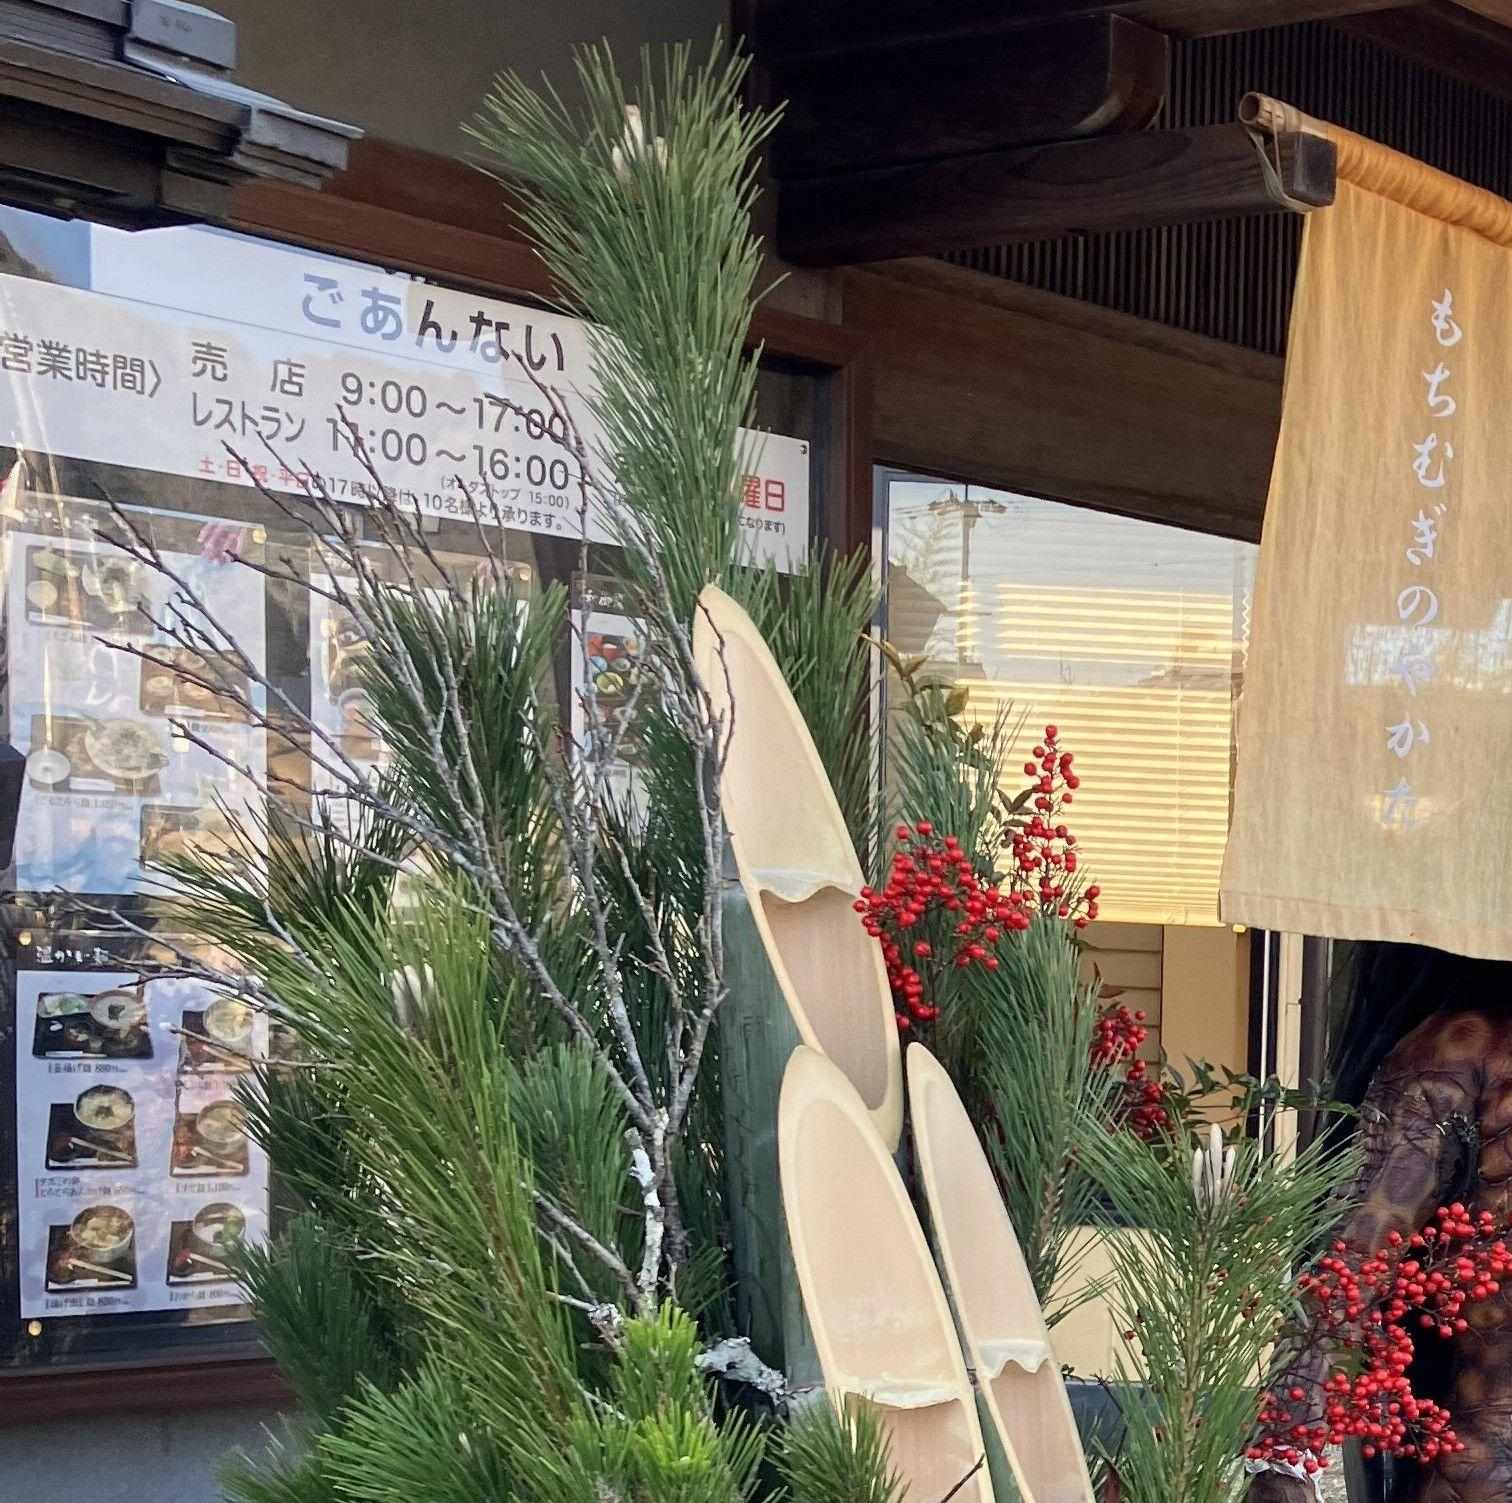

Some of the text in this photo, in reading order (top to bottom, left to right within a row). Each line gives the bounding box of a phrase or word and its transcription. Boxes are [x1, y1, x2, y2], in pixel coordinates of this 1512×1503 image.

[302, 273, 565, 371] ごあんない
[192, 392, 305, 442] レストラン
